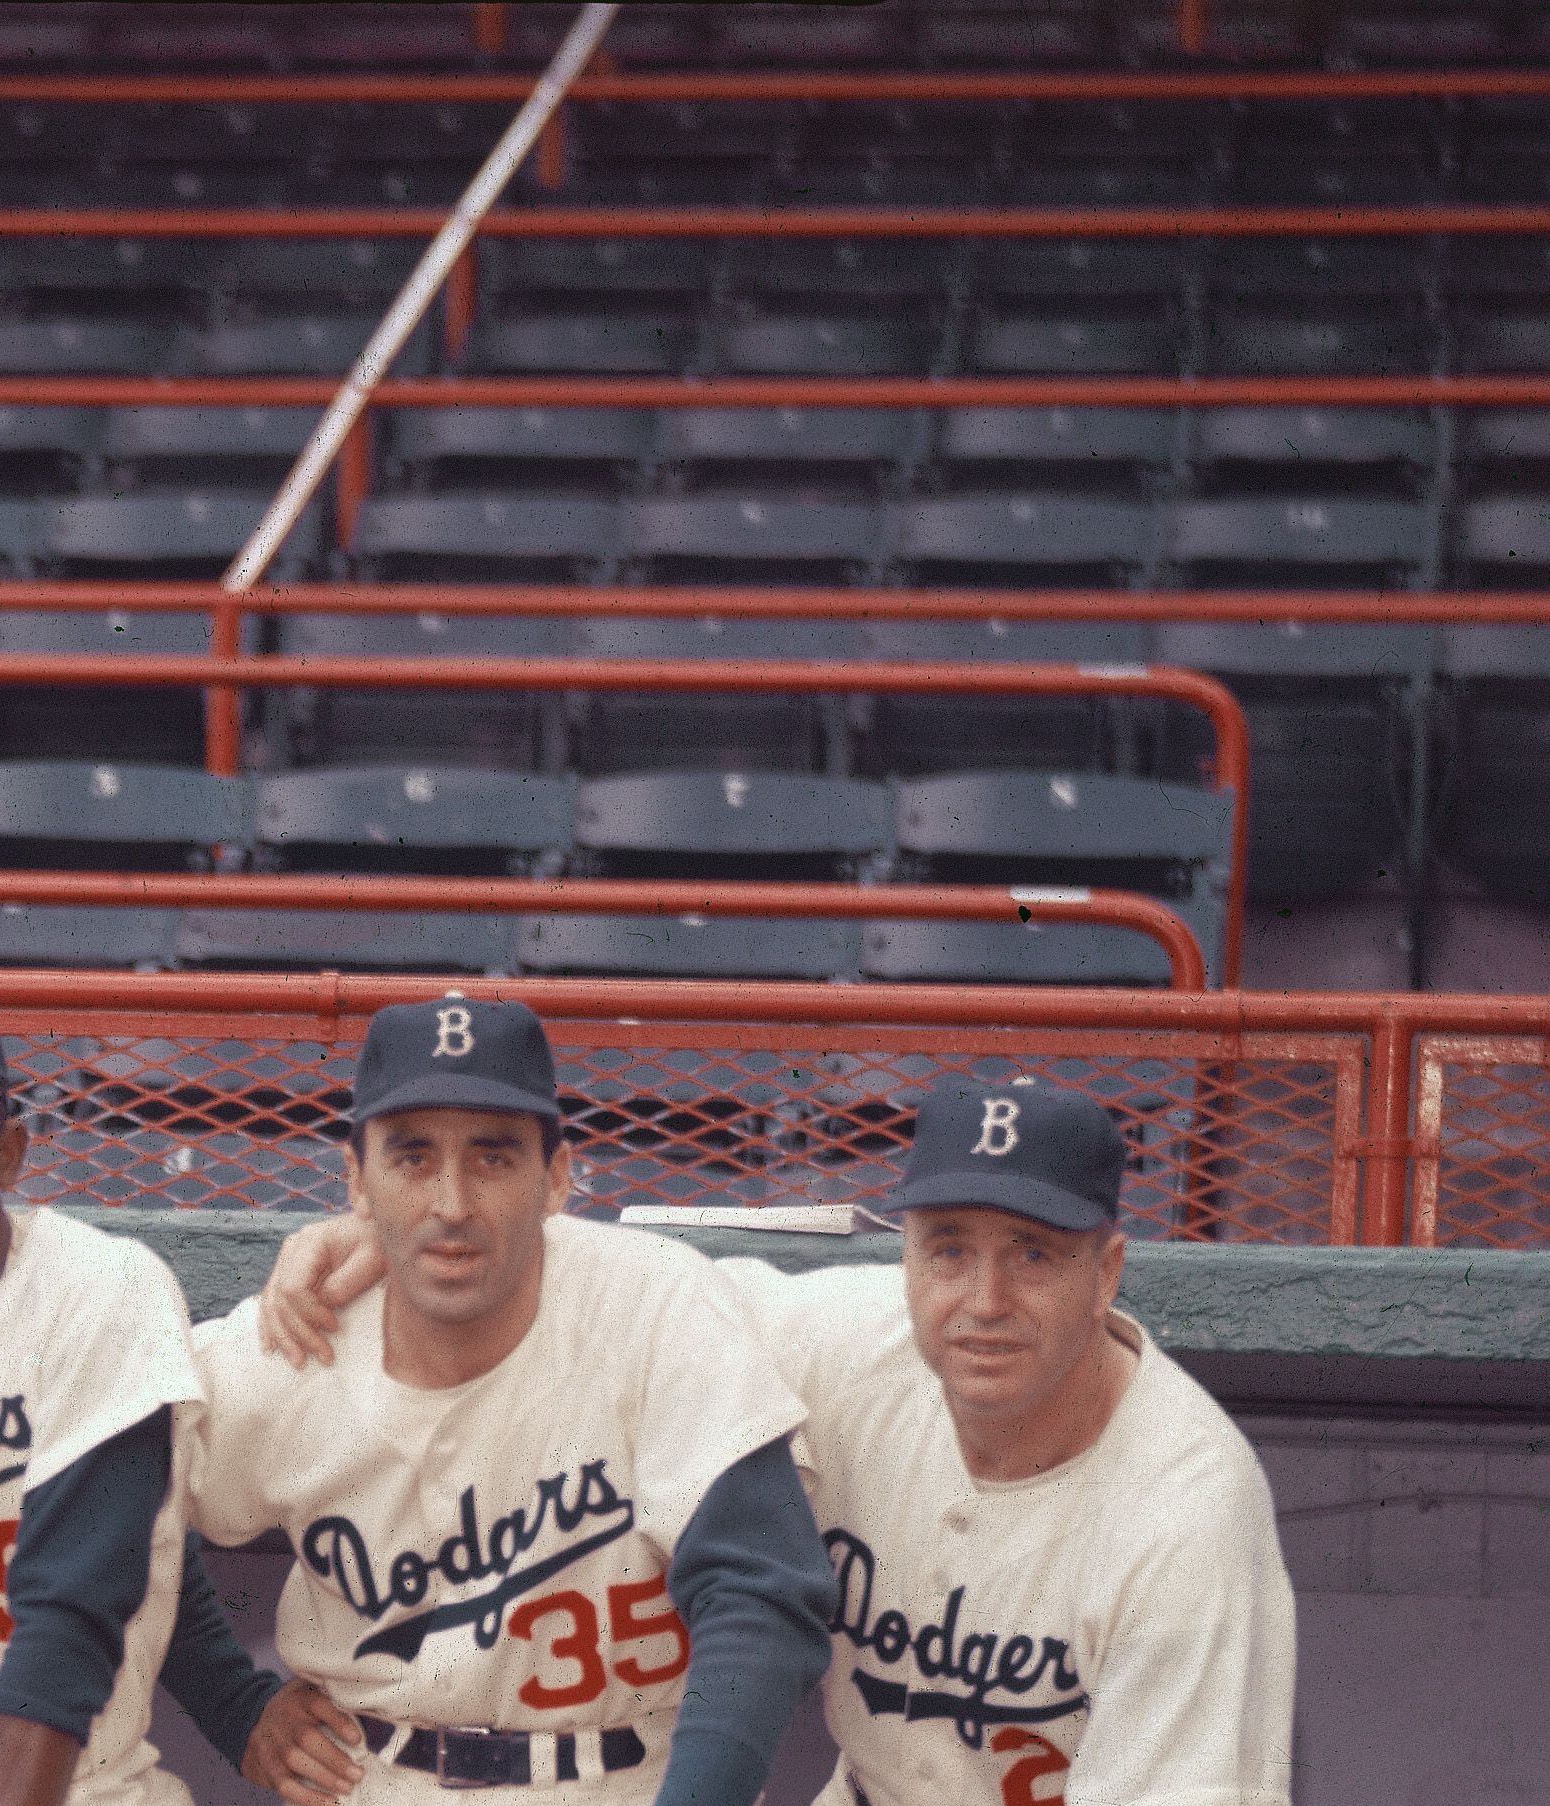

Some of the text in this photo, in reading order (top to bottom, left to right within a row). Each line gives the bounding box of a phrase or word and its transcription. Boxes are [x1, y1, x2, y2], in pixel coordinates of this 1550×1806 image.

[432, 1007, 475, 1057] B
[970, 1099, 1021, 1157] B
[508, 1573, 692, 1709] 35
